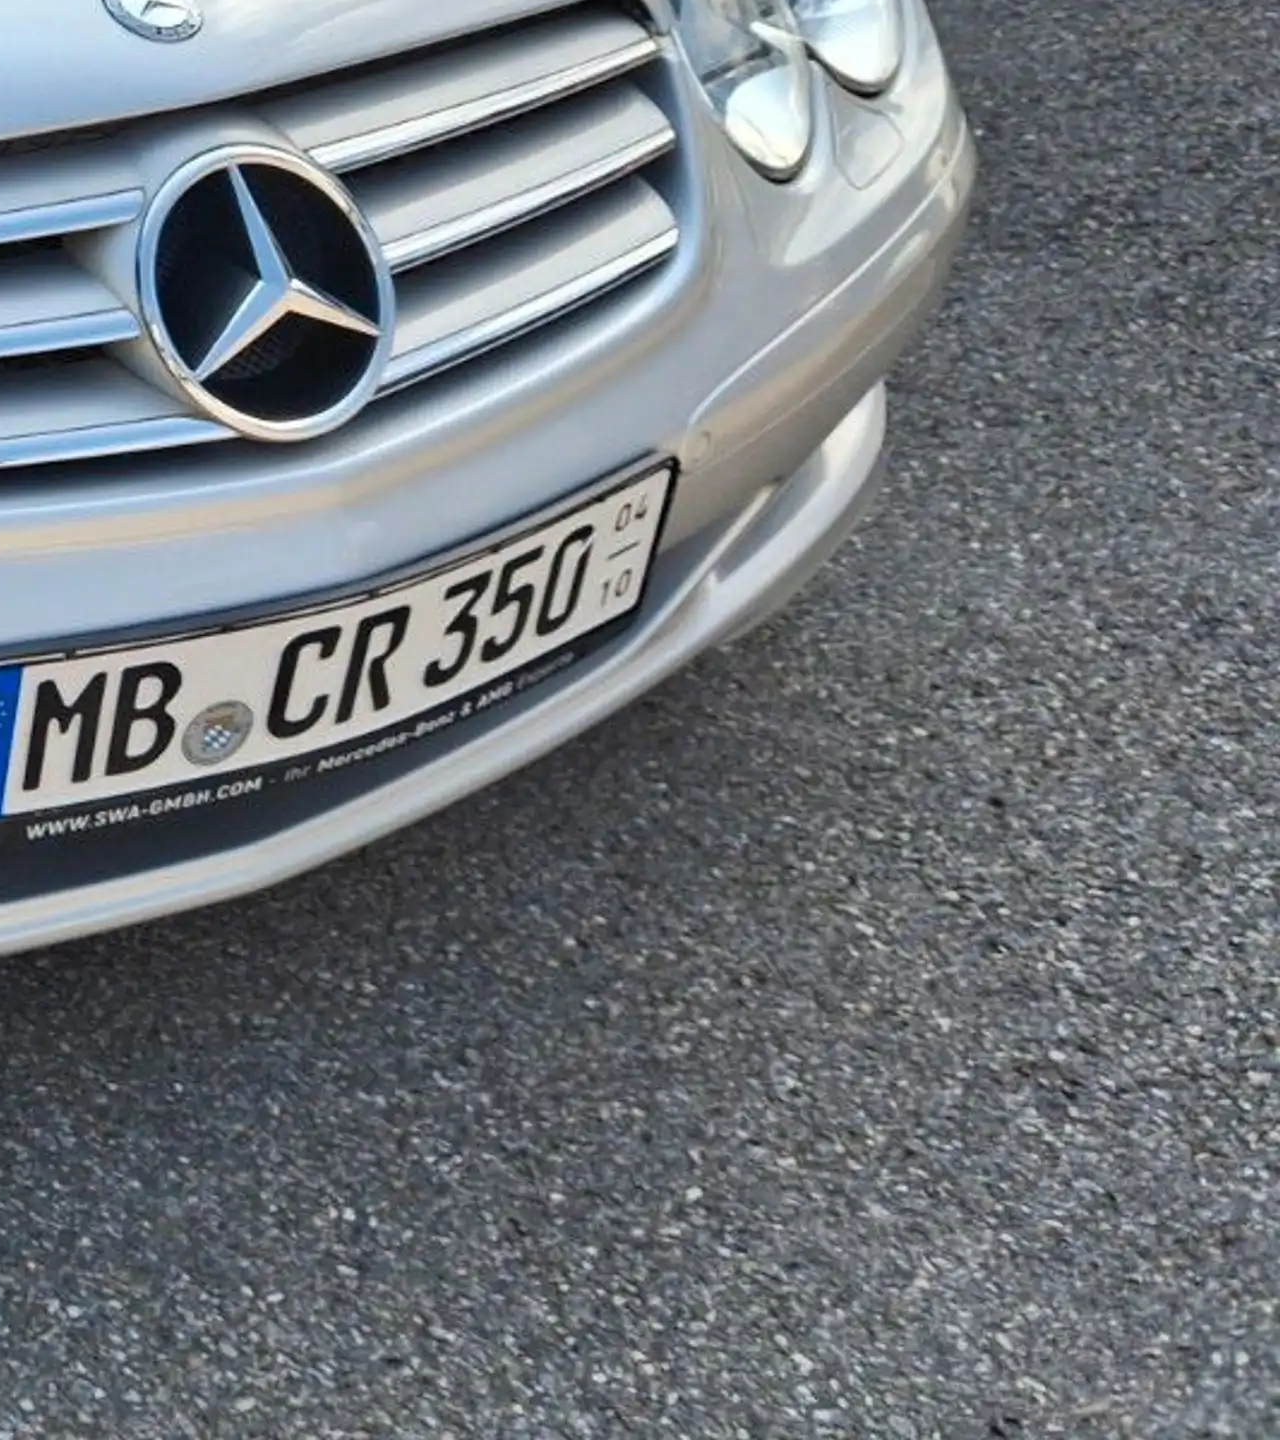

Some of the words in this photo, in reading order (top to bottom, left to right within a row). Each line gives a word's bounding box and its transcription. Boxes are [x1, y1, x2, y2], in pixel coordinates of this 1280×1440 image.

[615, 492, 648, 532] 04
[600, 568, 633, 608] 10
[22, 661, 182, 792] MB
[267, 605, 412, 738] CR
[423, 524, 594, 688] 350
[25, 776, 263, 841] WWW.SWA-GMBH.COM
